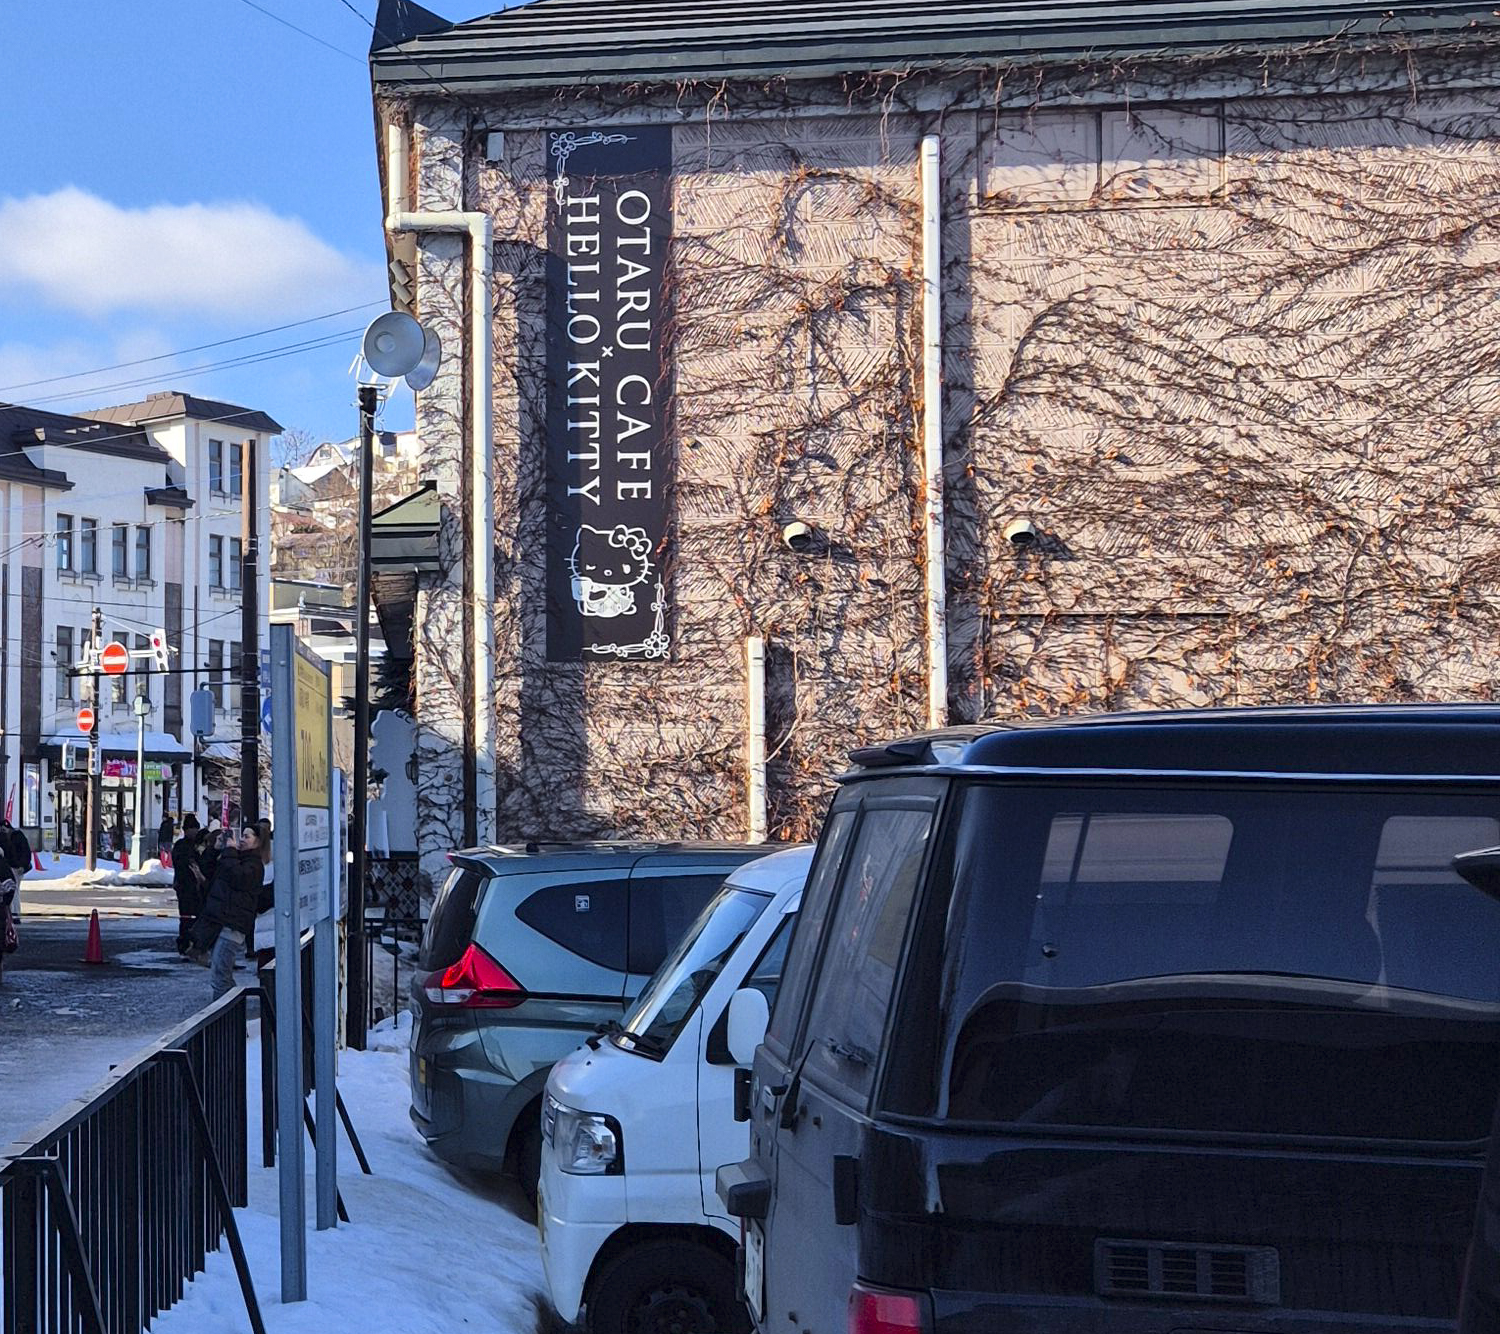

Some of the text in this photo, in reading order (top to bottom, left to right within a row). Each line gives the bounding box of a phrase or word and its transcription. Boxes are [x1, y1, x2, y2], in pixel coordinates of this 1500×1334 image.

[566, 193, 601, 506] HELLO KITTY
[615, 189, 652, 501] OTARU CAFE
